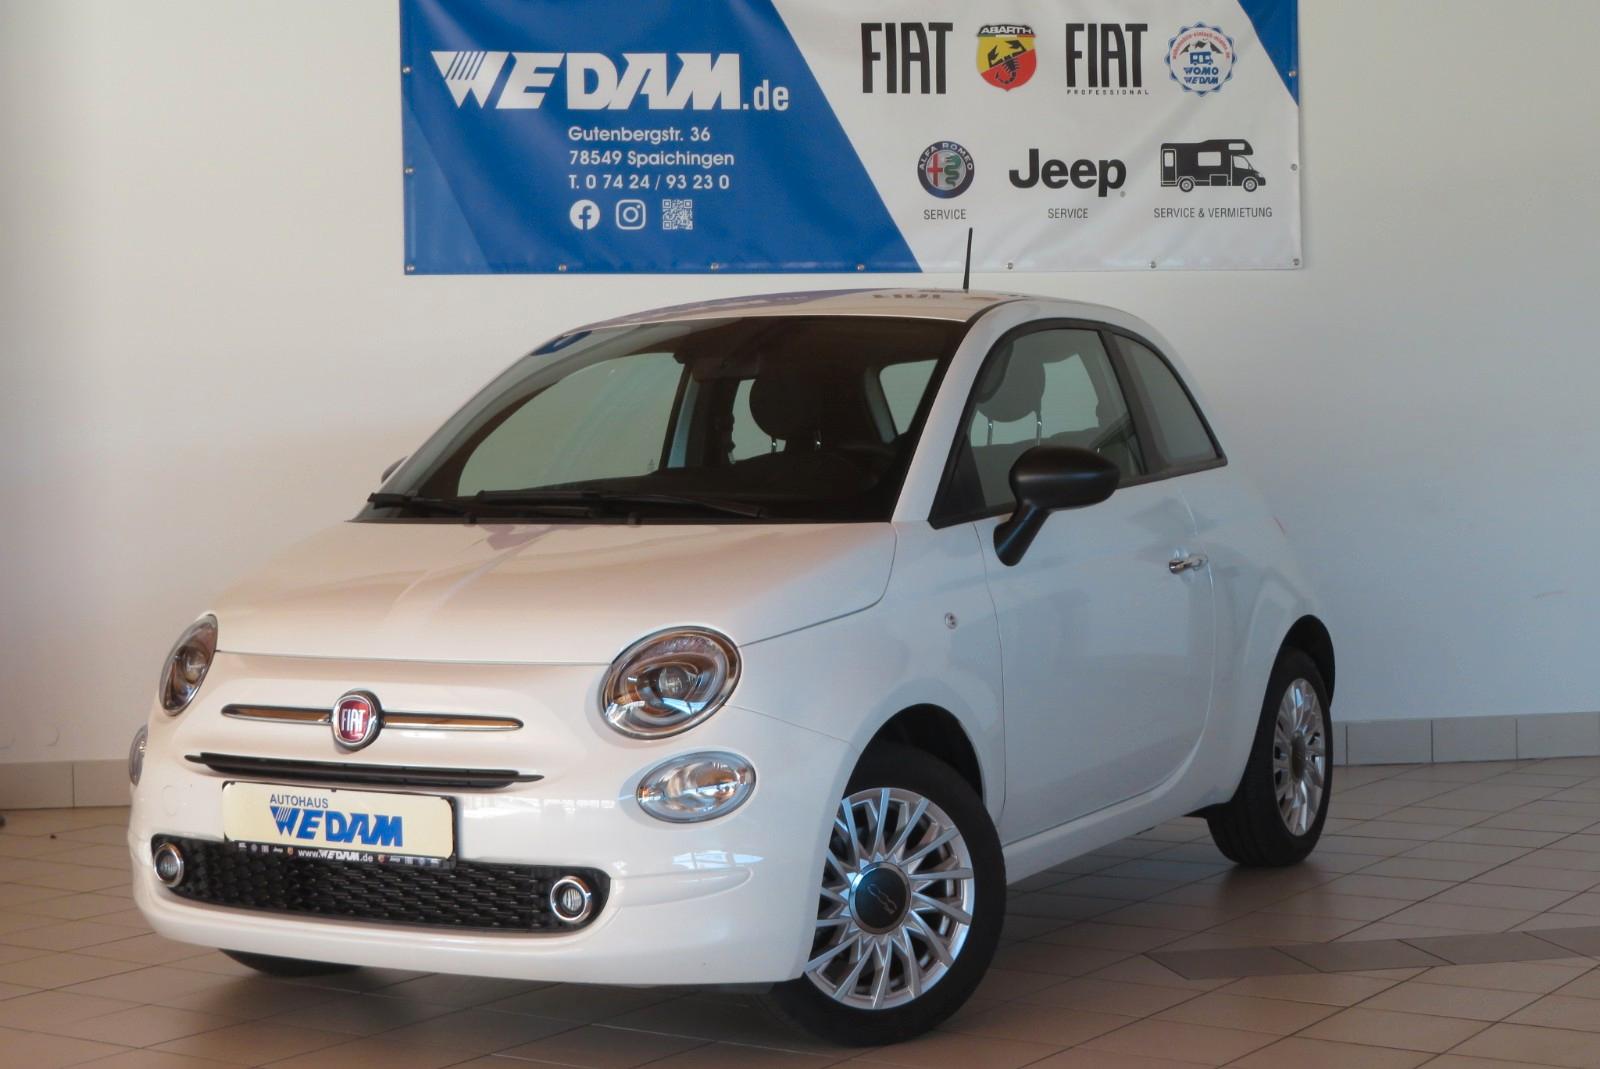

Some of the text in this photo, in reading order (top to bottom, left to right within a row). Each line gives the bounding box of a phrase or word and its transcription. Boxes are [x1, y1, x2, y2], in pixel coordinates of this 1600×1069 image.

[980, 26, 1032, 35] ABARTH
[861, 22, 953, 94] FIAT
[1066, 23, 1148, 88] FIAT
[1183, 67, 1219, 75] WOMO
[568, 126, 711, 145] Gutenbergstr. 36
[570, 150, 735, 169] 78549 Spaichingen
[919, 142, 973, 170] ALFA ROMEO
[568, 174, 580, 190] T.
[585, 174, 597, 190] 0
[603, 174, 624, 190] 74
[629, 174, 650, 190] 24
[666, 174, 687, 190] 93
[692, 174, 713, 190] 23
[719, 174, 730, 190] 0
[1009, 148, 1127, 198] Jeep
[923, 209, 967, 220] SERVICE
[1047, 208, 1089, 219] SERVICE
[1153, 206, 1273, 218] SERVICE & VERMIETUNG
[341, 708, 366, 734] FIAT
[270, 794, 329, 809] AUTOHAUS
[269, 806, 403, 847] WEDAM
